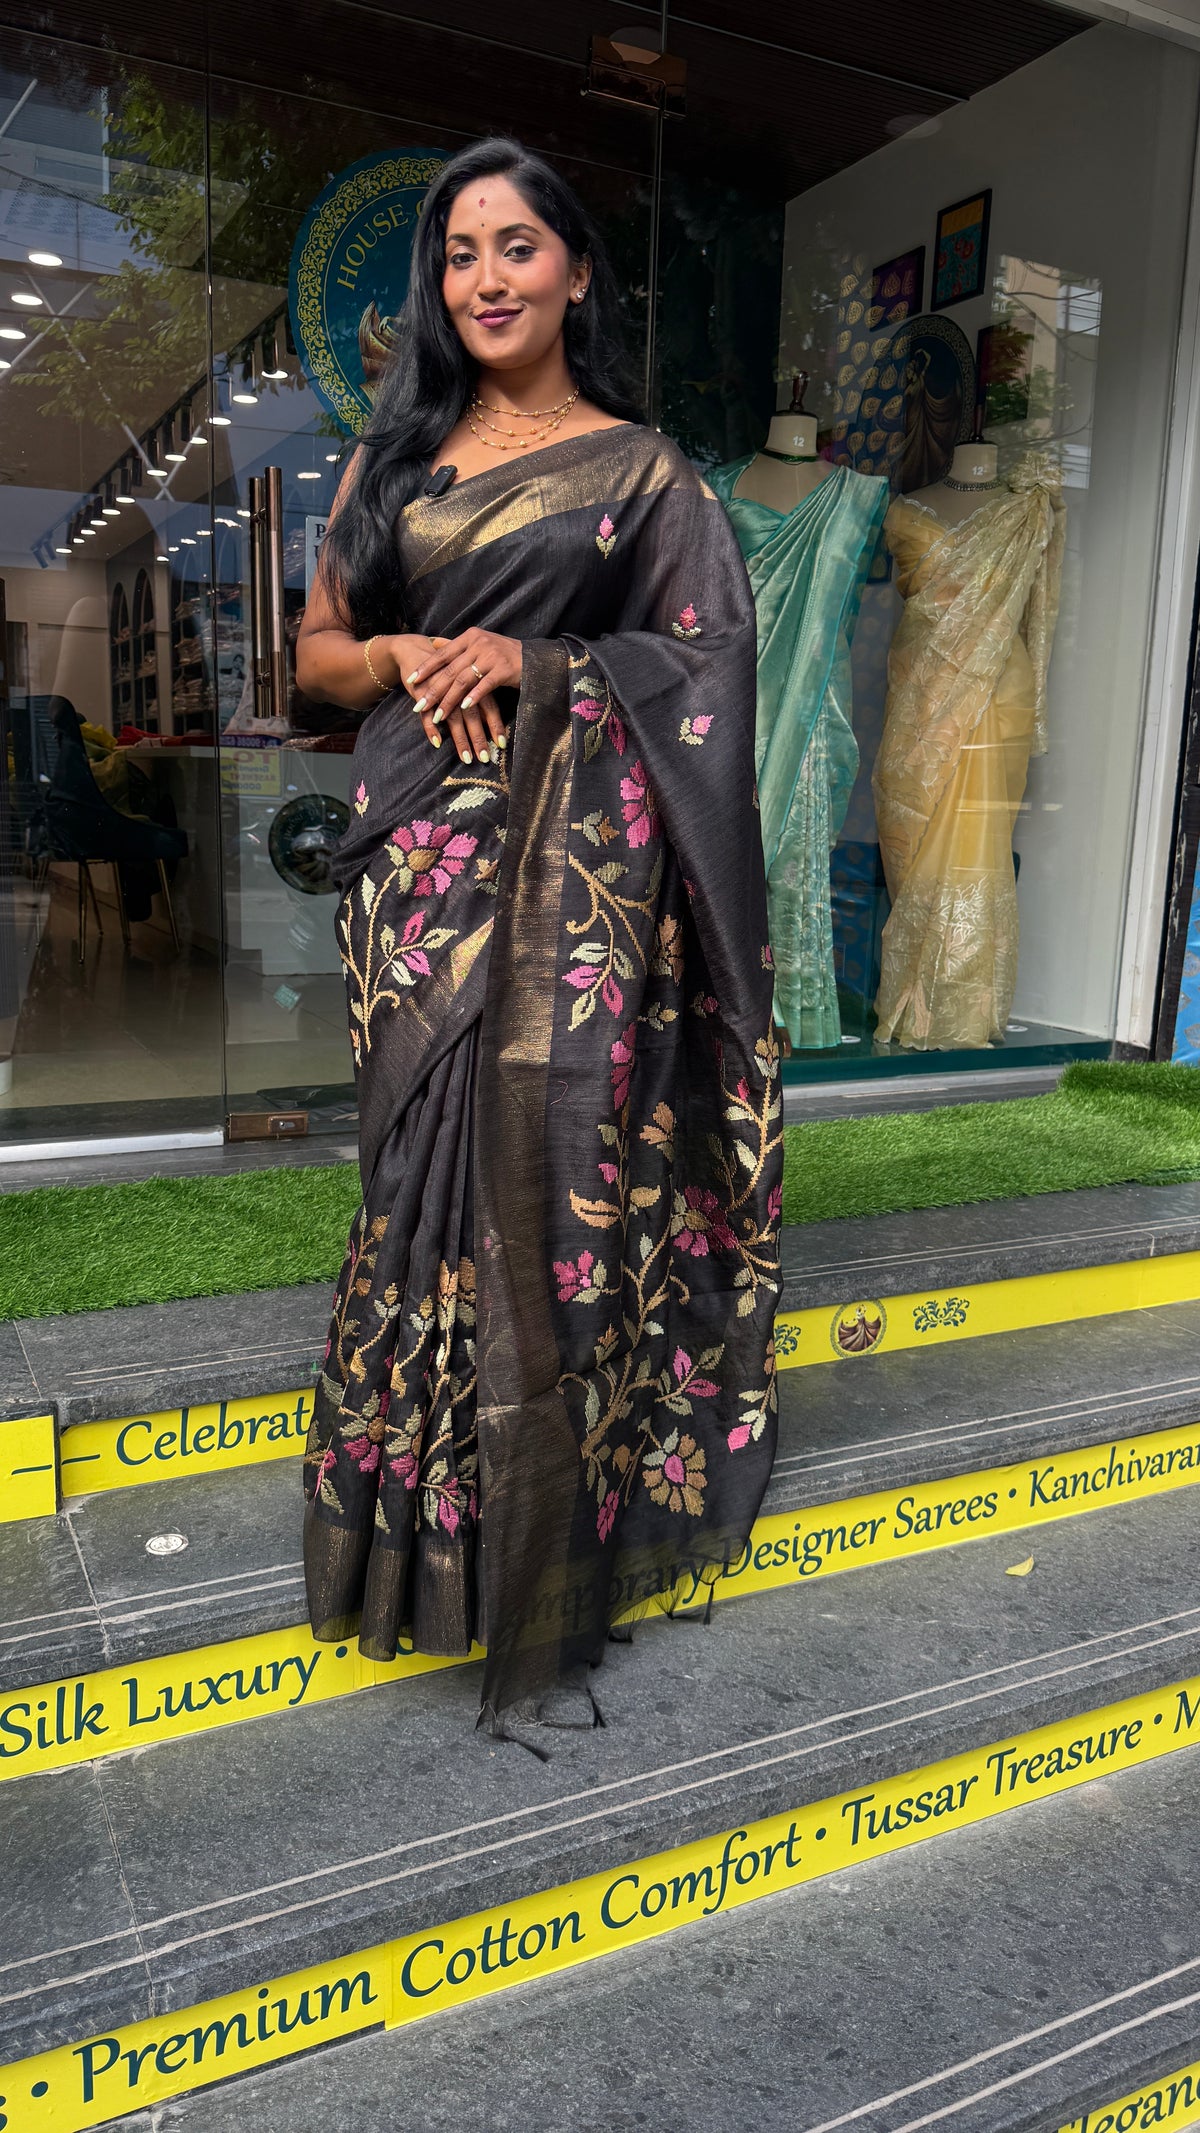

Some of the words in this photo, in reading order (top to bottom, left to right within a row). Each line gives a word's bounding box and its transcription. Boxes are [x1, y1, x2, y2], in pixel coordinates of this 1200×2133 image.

[337, 204, 409, 291] HOUSE
[793, 436, 804, 447] 12
[116, 1396, 310, 1466] Celebrat
[722, 1515, 887, 1576] Designer
[894, 1490, 998, 1538] Sarees
[0, 1683, 110, 1757] Silk
[121, 1650, 322, 1727] Luxury
[72, 1971, 378, 2103] Premium
[401, 1911, 586, 1998] Cotton
[600, 1822, 802, 1930] Comfort
[841, 1775, 979, 1846] Tussar
[986, 1720, 1143, 1796] Treasure
